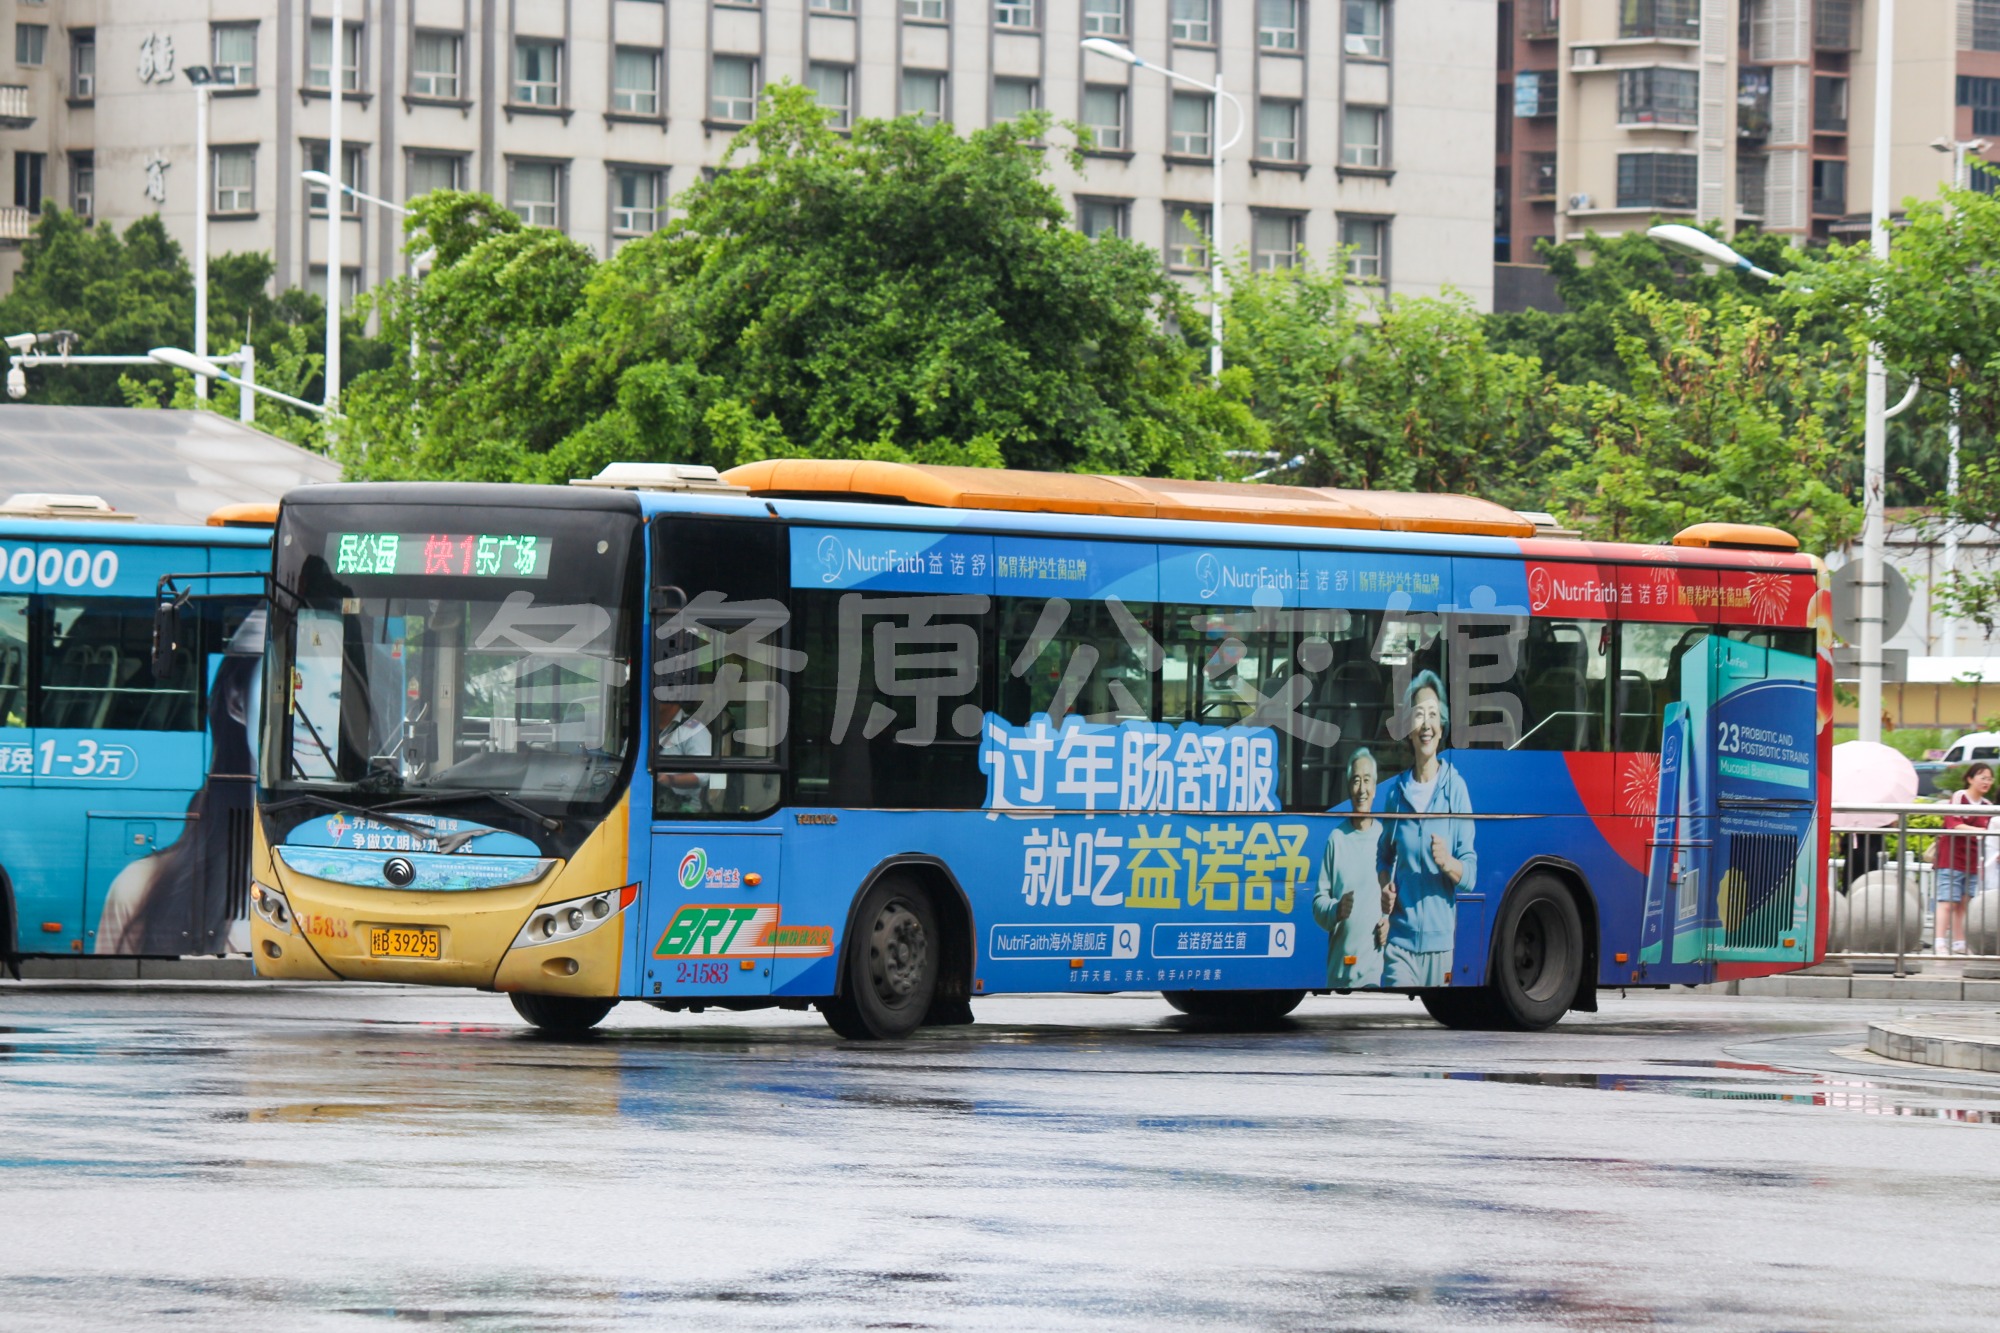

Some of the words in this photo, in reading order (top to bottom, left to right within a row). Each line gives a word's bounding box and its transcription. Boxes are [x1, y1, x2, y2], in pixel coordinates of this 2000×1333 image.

[0, 546, 119, 589] 0000
[337, 533, 400, 575] 民公园
[424, 534, 475, 575] 快1
[475, 534, 537, 576] 东广场
[848, 547, 925, 575] NutriFaith
[928, 552, 986, 577] 益诺舒
[998, 555, 1087, 582] 肠胃养护益生菌品牌
[1223, 565, 1293, 590] NutriFaith
[1296, 569, 1350, 592] 益诺舒
[1359, 571, 1440, 595] 肠胃养护益生菌品牌
[1553, 579, 1618, 603] NutriFaith
[1620, 583, 1669, 606] 益诺舒
[1678, 585, 1752, 608] 肠胃养护益生菌品牌
[1717, 721, 1741, 754] 23
[1741, 726, 1778, 744] PROBIOTIC
[1779, 733, 1793, 746] AND
[1741, 741, 1781, 760] POSTBIOTIC
[1782, 748, 1809, 765] STRAINS
[985, 721, 1276, 822] 过年肠舒服
[1720, 759, 1749, 776] Mucosal
[1021, 821, 1311, 915] 就吃益诺舒
[656, 907, 759, 956] BRT
[997, 931, 1108, 953] NutriFaith海外旗舰店
[1177, 931, 1247, 951] 益诺舒益生菌
[676, 962, 729, 985] 2-1583
